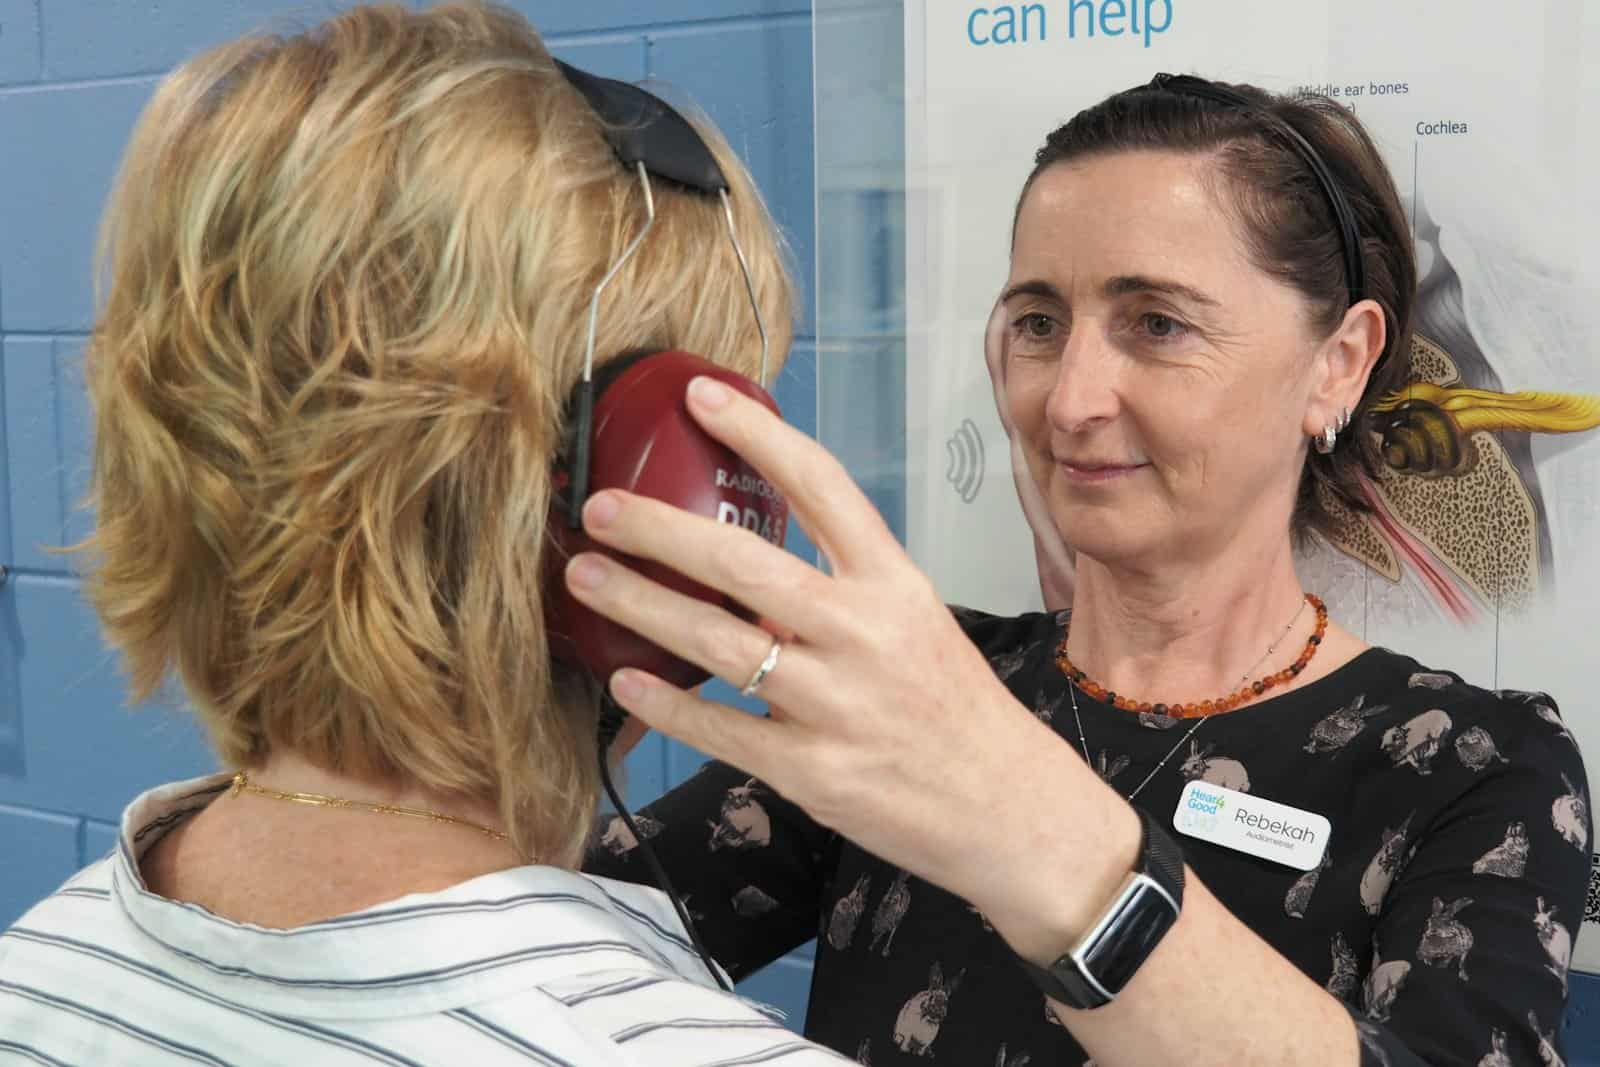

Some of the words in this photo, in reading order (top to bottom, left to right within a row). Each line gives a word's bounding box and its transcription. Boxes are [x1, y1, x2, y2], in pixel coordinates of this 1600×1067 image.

[967, 3, 1046, 46] can
[1069, 0, 1173, 48] help
[1297, 84, 1340, 98] Middle
[1344, 85, 1365, 97] ear
[1369, 81, 1409, 96] bones
[1416, 120, 1468, 136] Cochlea
[718, 500, 783, 545] DD65
[1187, 798, 1217, 815] Good
[1234, 807, 1316, 844] Rebekah
